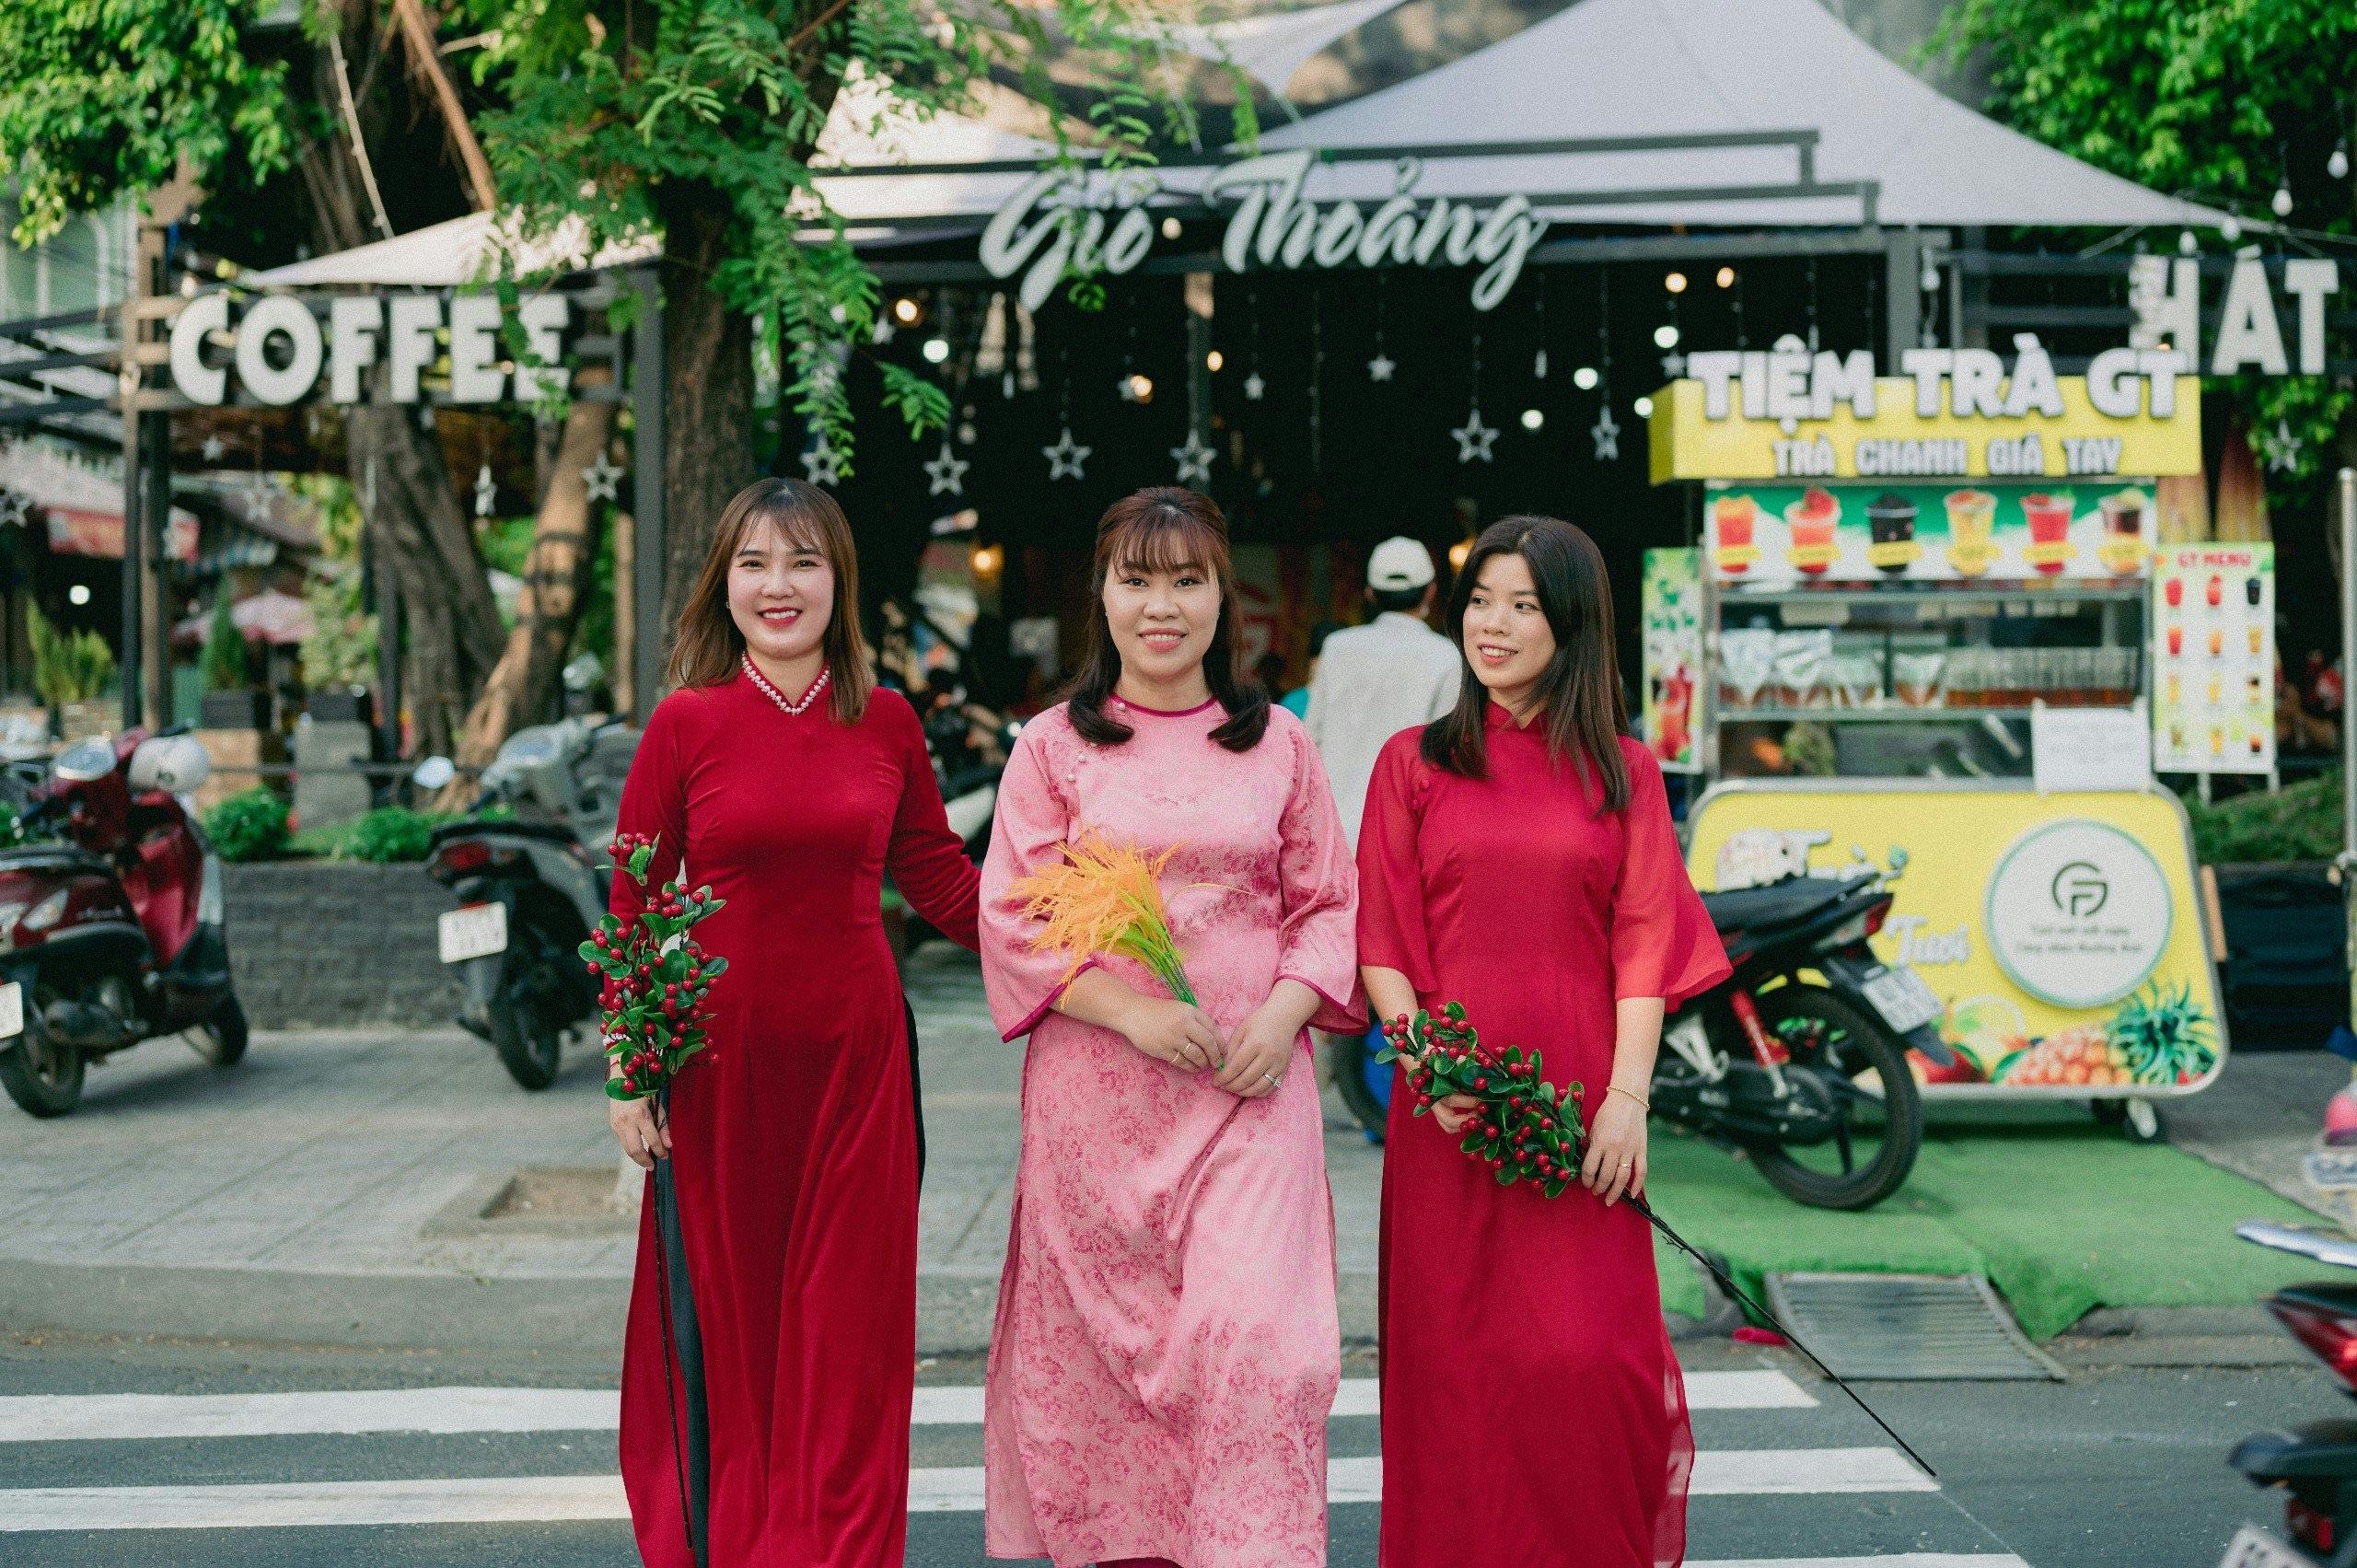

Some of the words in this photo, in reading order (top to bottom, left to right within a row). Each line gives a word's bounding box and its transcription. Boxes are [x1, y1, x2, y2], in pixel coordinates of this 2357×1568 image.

[169, 294, 570, 405] COFFEE
[1687, 333, 1875, 436] TIỆM
[1902, 332, 2065, 418] TRÀ
[2086, 348, 2188, 420] GT
[1771, 434, 1836, 477] TRÀ
[1855, 438, 1968, 477] CHANH
[2061, 436, 2122, 476] TAY
